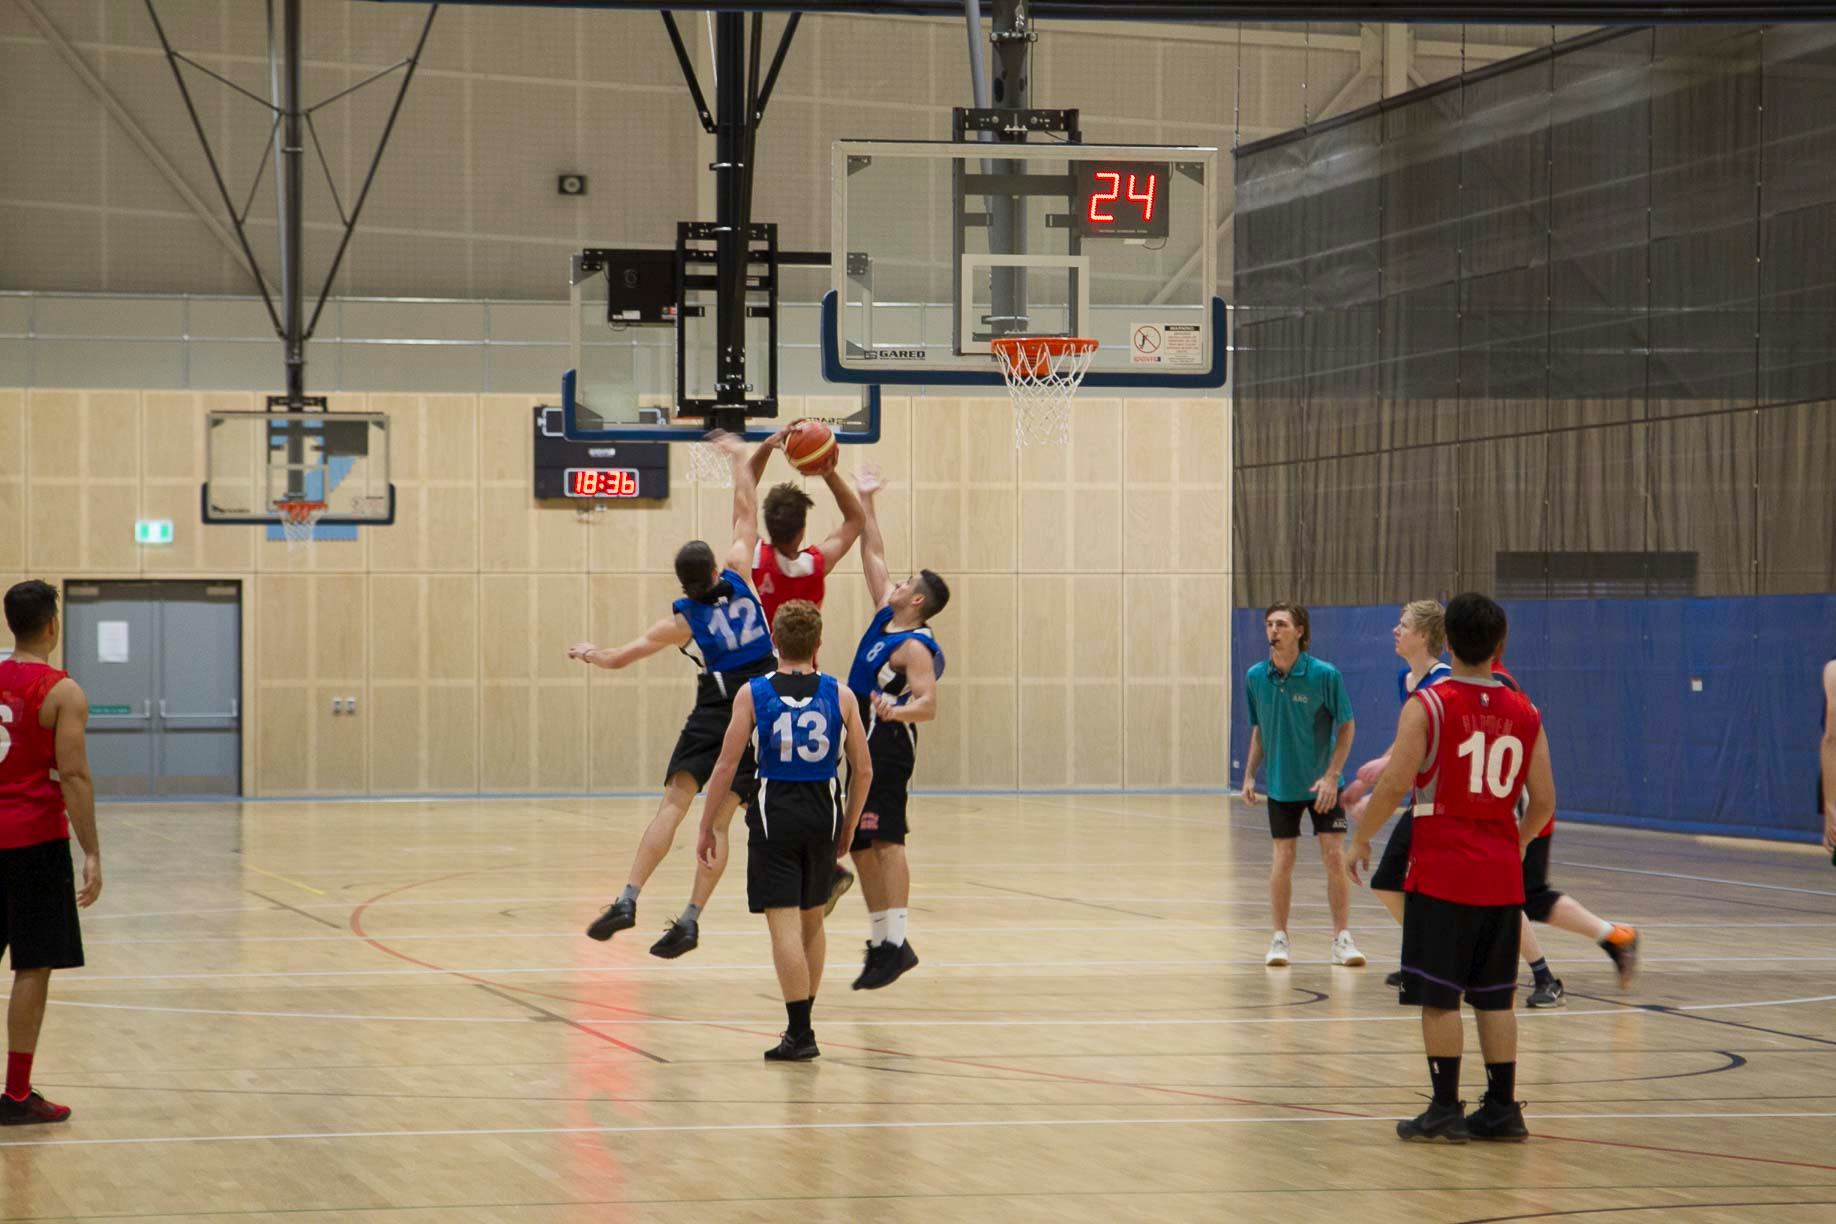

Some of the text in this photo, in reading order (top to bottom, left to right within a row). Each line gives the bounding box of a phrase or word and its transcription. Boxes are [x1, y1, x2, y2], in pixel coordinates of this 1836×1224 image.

[1088, 171, 1156, 222] 24
[879, 350, 926, 358] GARED
[574, 470, 636, 496] 18:36
[707, 597, 765, 651] 12
[866, 641, 886, 662] 8
[772, 710, 831, 763] 13
[1457, 730, 1524, 799] 10
